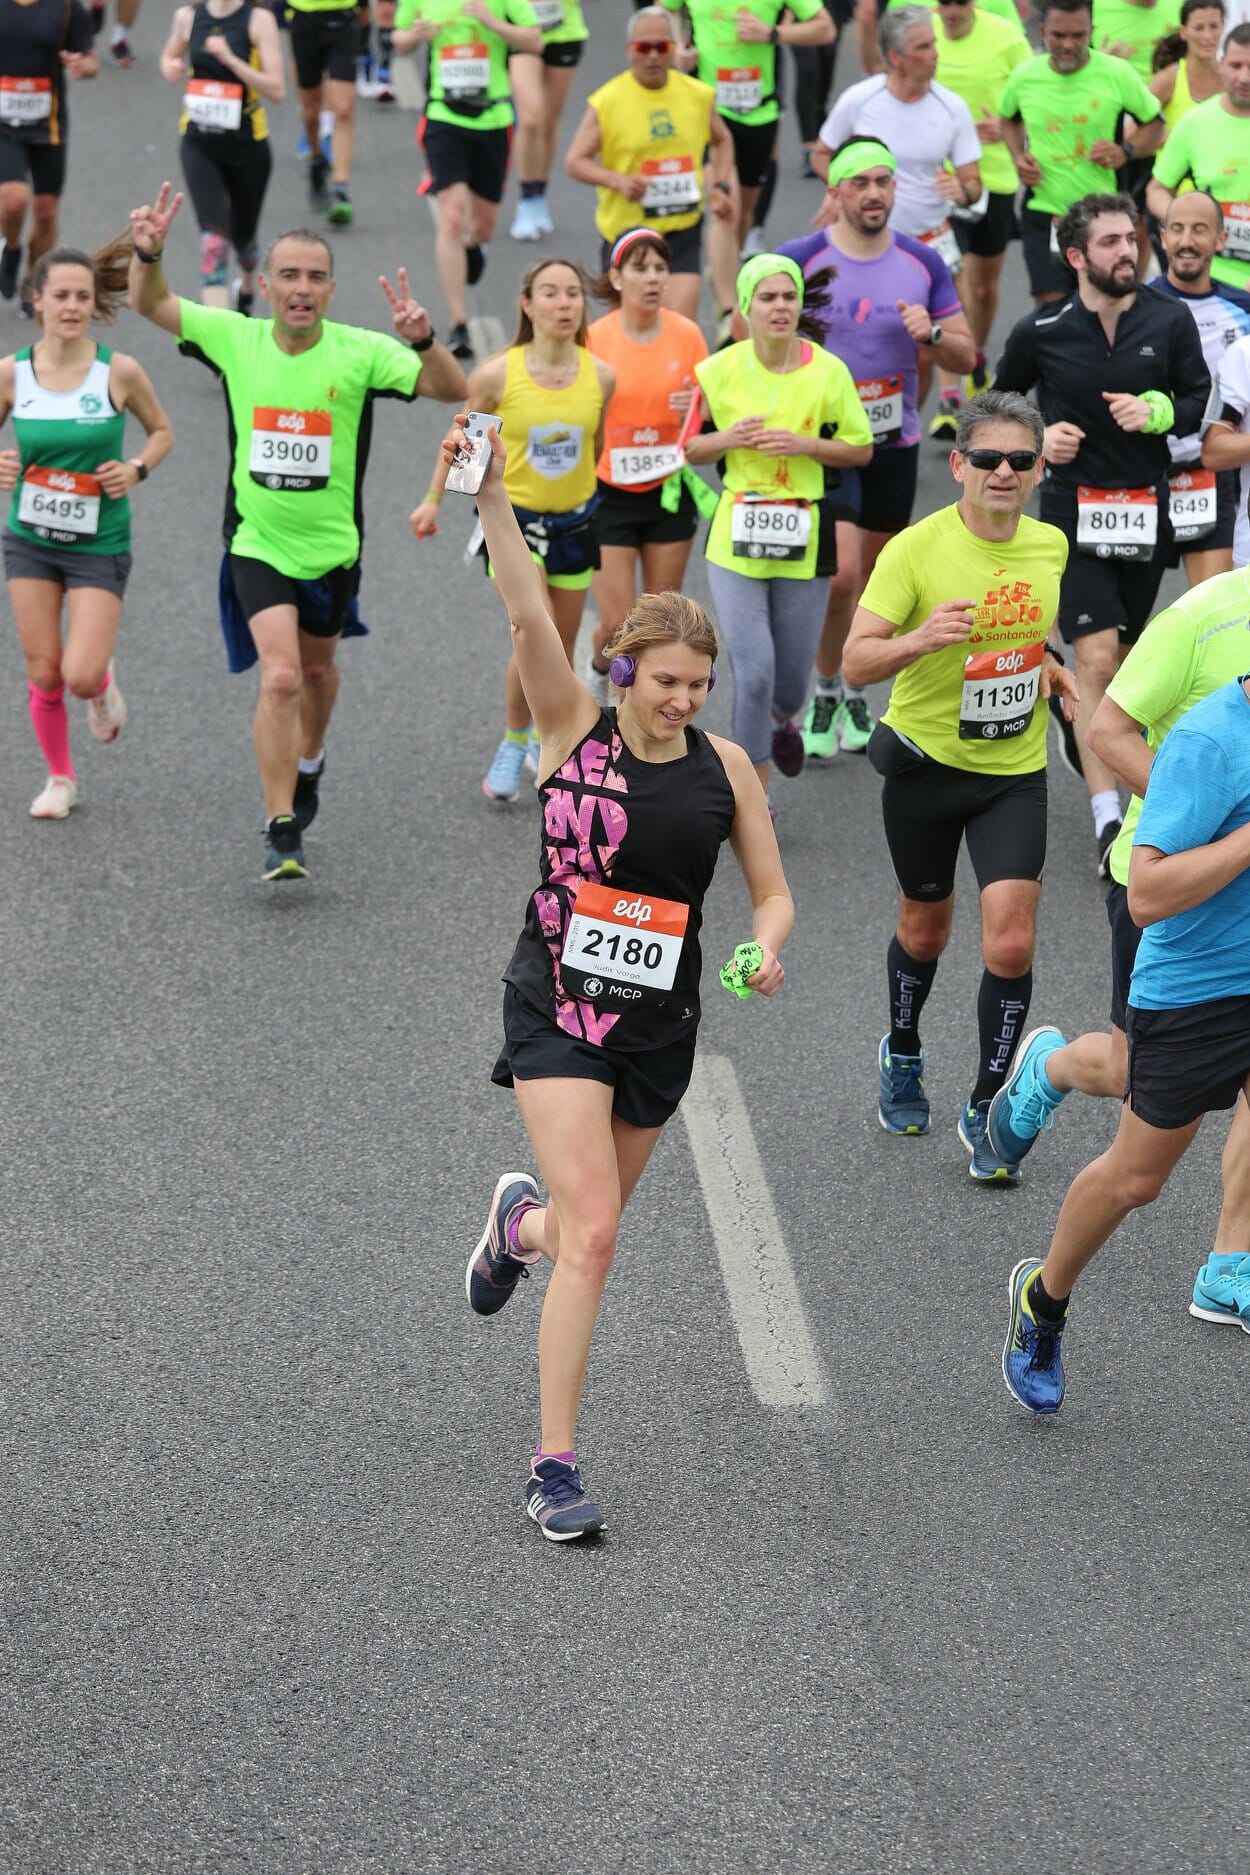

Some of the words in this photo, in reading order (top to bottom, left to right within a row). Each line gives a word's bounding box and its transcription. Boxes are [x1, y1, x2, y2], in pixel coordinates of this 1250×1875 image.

[277, 412, 306, 433] edp
[632, 426, 659, 446] edp
[262, 439, 318, 463] 3900
[48, 471, 77, 491] edp
[284, 478, 311, 488] MCP
[33, 494, 86, 520] 6495
[744, 511, 799, 532] 8980
[1091, 511, 1146, 531] 8014
[1176, 526, 1199, 537] MCP
[764, 546, 790, 557] MCP
[1114, 545, 1139, 556] MCP
[985, 629, 1043, 641] Santander
[995, 651, 1025, 673] edp
[973, 678, 1034, 708] 11301
[1003, 719, 1025, 734] MCP
[612, 897, 653, 927] edp
[581, 928, 663, 970] 2180
[608, 984, 642, 1000] MCP
[894, 970, 922, 1029] Kalenji
[989, 1000, 1025, 1073] Kalenji
